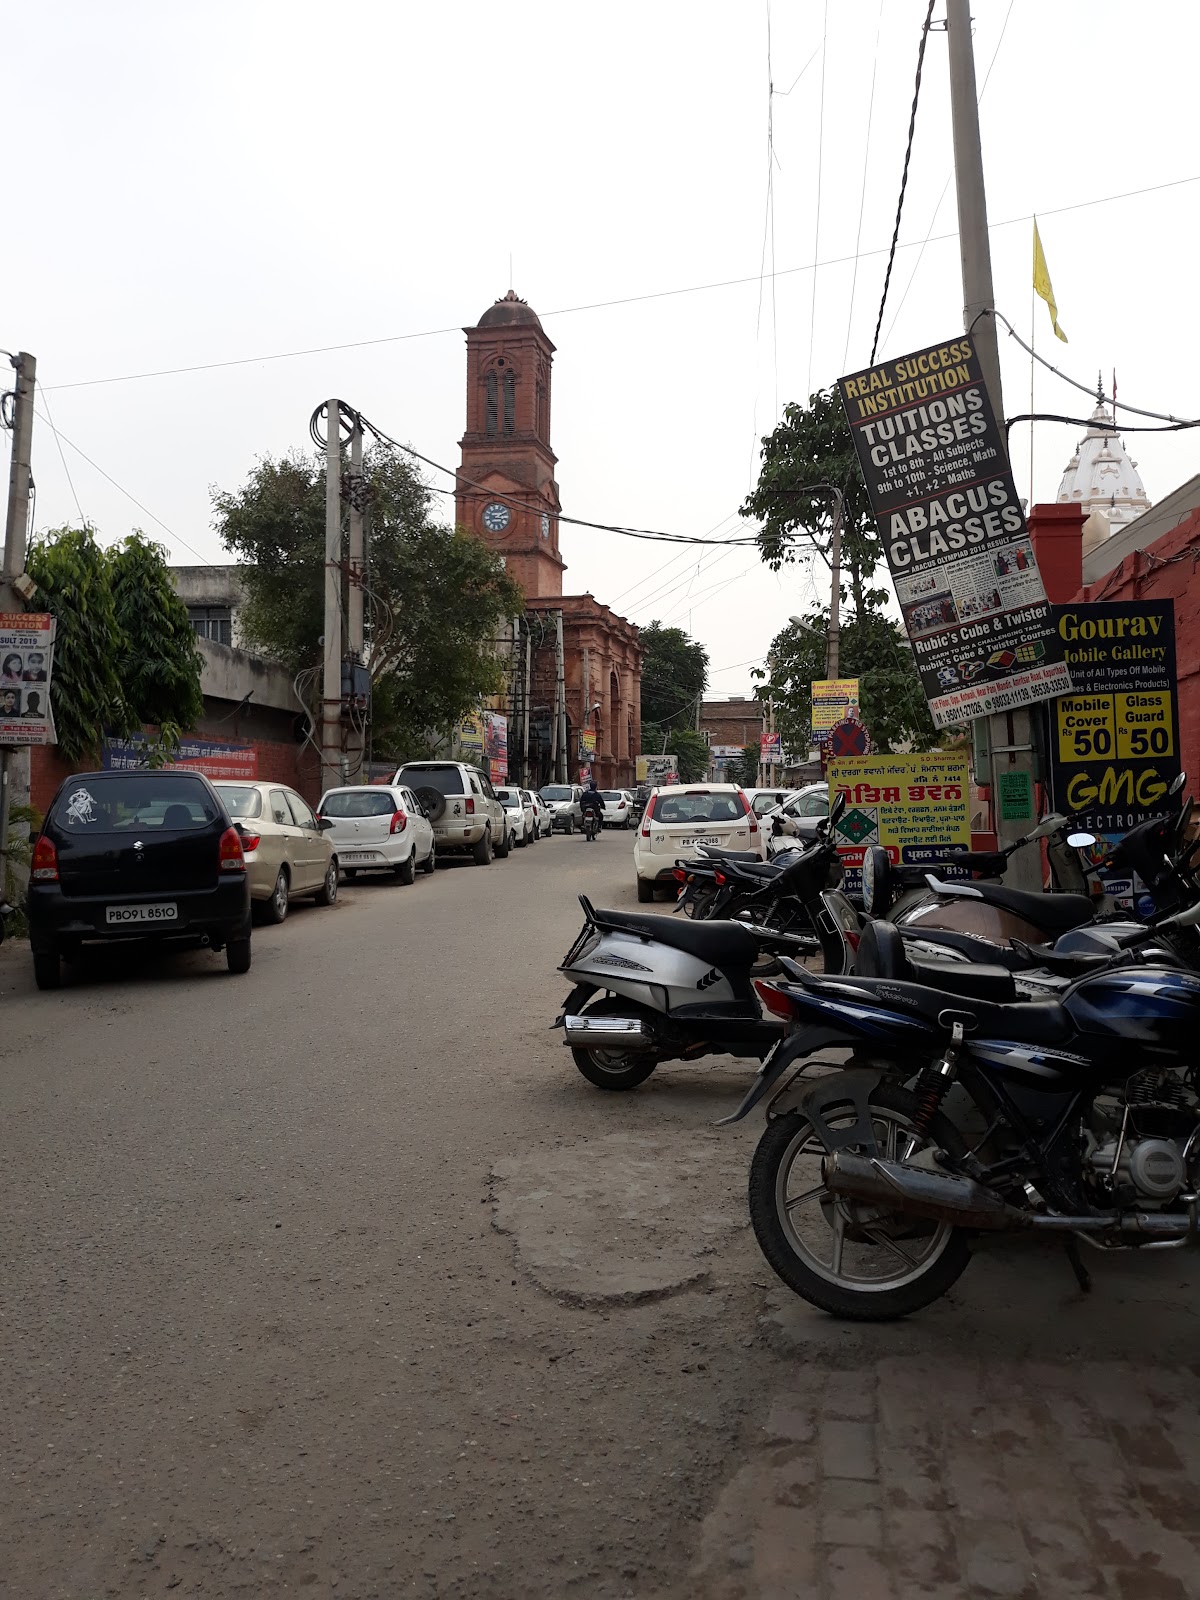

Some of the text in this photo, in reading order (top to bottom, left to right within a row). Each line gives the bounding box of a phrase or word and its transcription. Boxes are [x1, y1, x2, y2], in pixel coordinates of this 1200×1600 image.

[843, 340, 972, 399] REAL SUCCESS
[857, 363, 970, 417] INSTITUTION
[859, 388, 982, 445] TUITIONS
[870, 412, 986, 466] CLASSES
[877, 481, 892, 494] 9th
[893, 478, 903, 488] to
[904, 470, 925, 484] 10th
[933, 457, 972, 475] Science,
[972, 446, 996, 462] Math
[882, 465, 897, 478] 1st
[897, 464, 907, 473] to
[908, 457, 924, 469] 8th
[932, 449, 945, 462] All
[945, 438, 984, 457] Subjects
[906, 485, 923, 497] +1,
[925, 478, 939, 491] +2
[946, 468, 975, 484] Maths
[890, 480, 1007, 539] ABACUS
[889, 505, 1021, 566] CLASSES
[911, 559, 936, 573] ABACUS
[936, 549, 968, 564] OLYMPIAD
[969, 543, 985, 554] 2018
[986, 536, 1009, 548] RESULT
[914, 606, 1046, 653] Rubic's Cube & Twister
[927, 650, 949, 661] LEARN
[977, 628, 1023, 646] CHALLENGING
[1023, 623, 1041, 631] TASK
[1059, 614, 1163, 641] Gourav
[919, 627, 1055, 672] Rubik's Cube & Twister Courses
[1064, 645, 1166, 664] obile Gallery
[1070, 665, 1165, 678] Unit of All Types Off Mobile
[1094, 682, 1133, 692] Electronics
[1135, 679, 1169, 689] Products)
[1062, 699, 1110, 712] Mobile
[1126, 696, 1162, 707] Glass
[1066, 716, 1108, 728] Cover
[1126, 710, 1164, 723] Guard
[828, 741, 833, 751] NO
[1074, 728, 1111, 756] 50
[1130, 728, 1168, 755] 50
[907, 785, 962, 801] ਭਵਨ
[1067, 766, 1167, 810] GMG
[109, 907, 175, 921] PB09 L 8510
